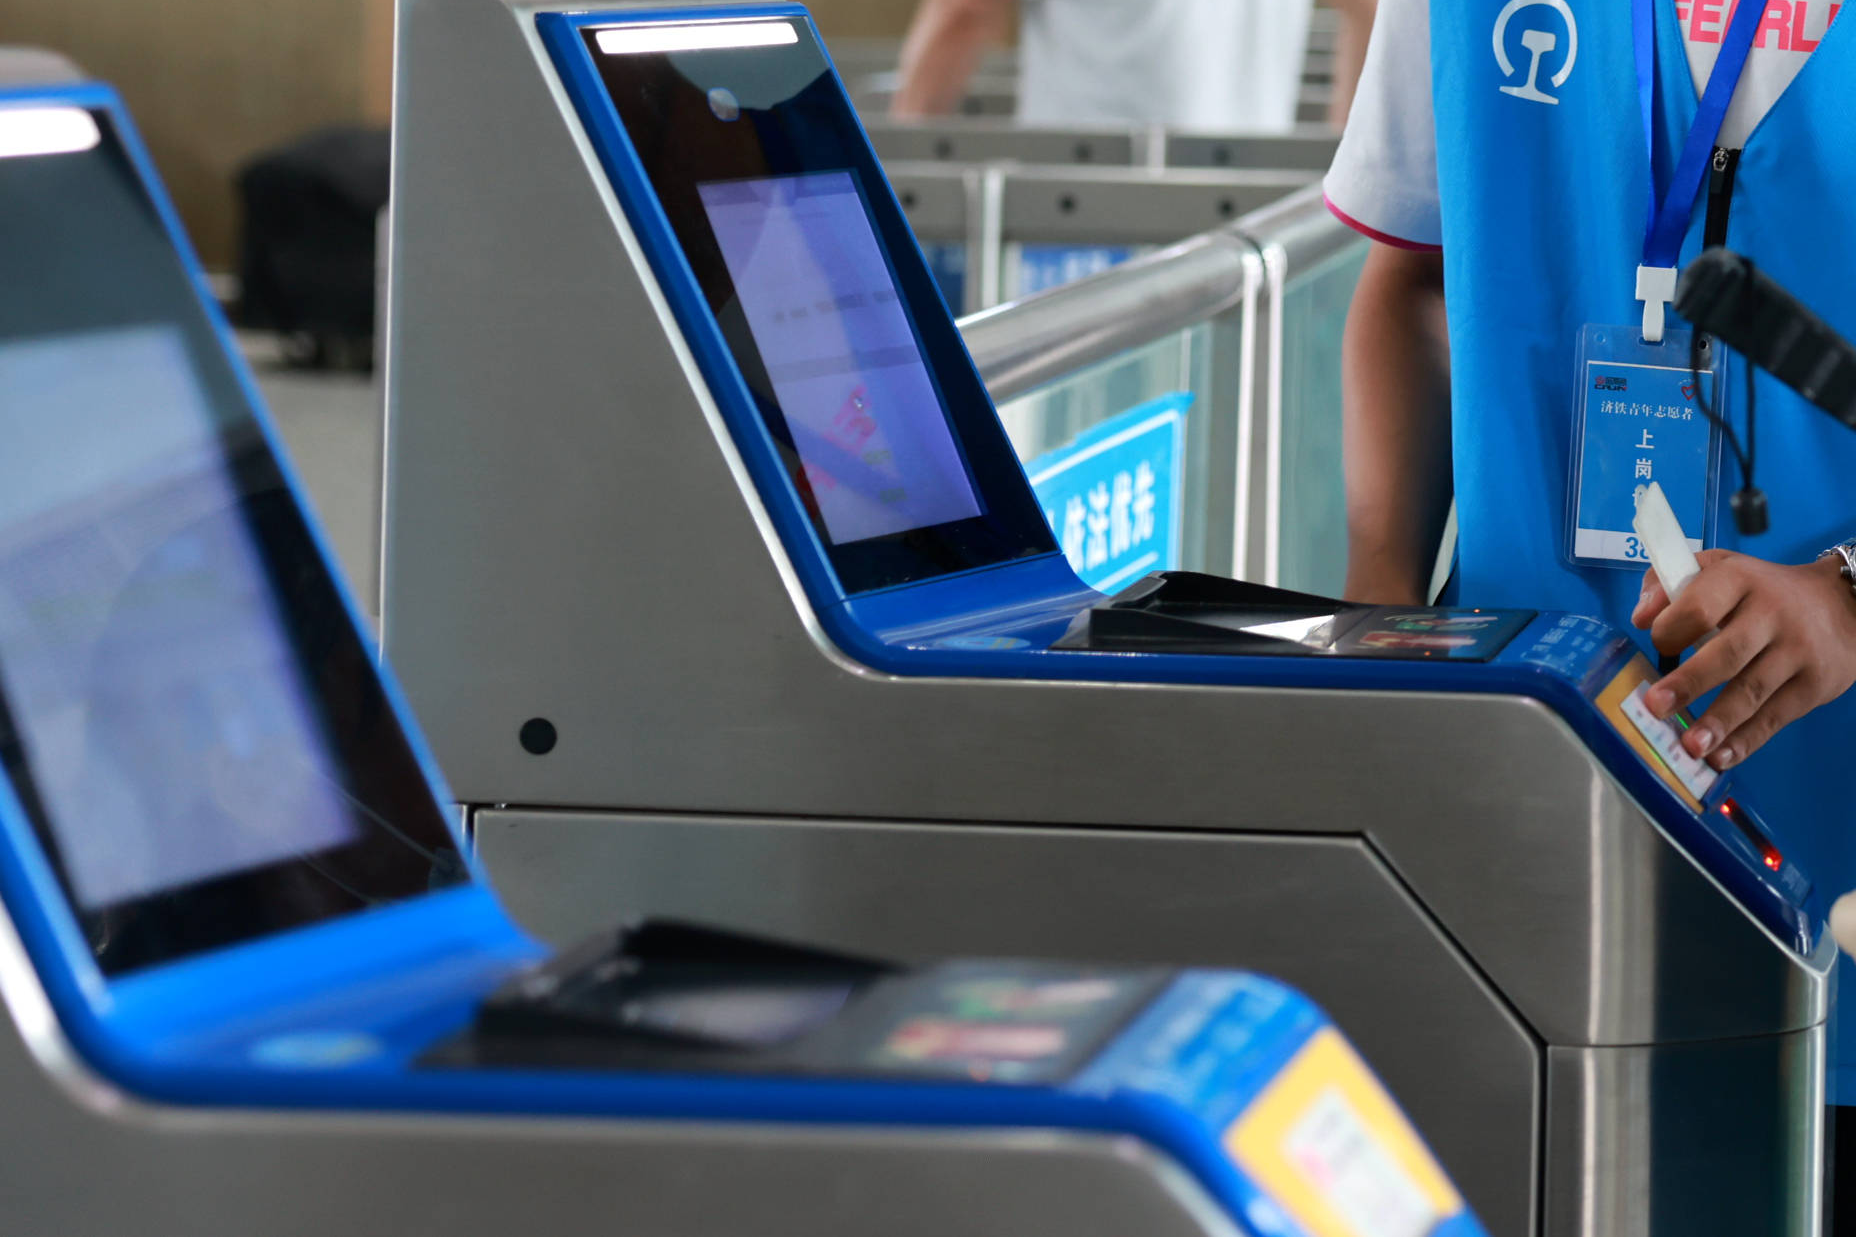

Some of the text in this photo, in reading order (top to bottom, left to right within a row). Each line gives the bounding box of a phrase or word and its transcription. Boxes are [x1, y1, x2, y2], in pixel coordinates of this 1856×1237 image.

[1600, 400, 1694, 420] 济铁青年志愿者
[1633, 428, 1655, 506] 上岗
[1047, 460, 1155, 573] 依法优先
